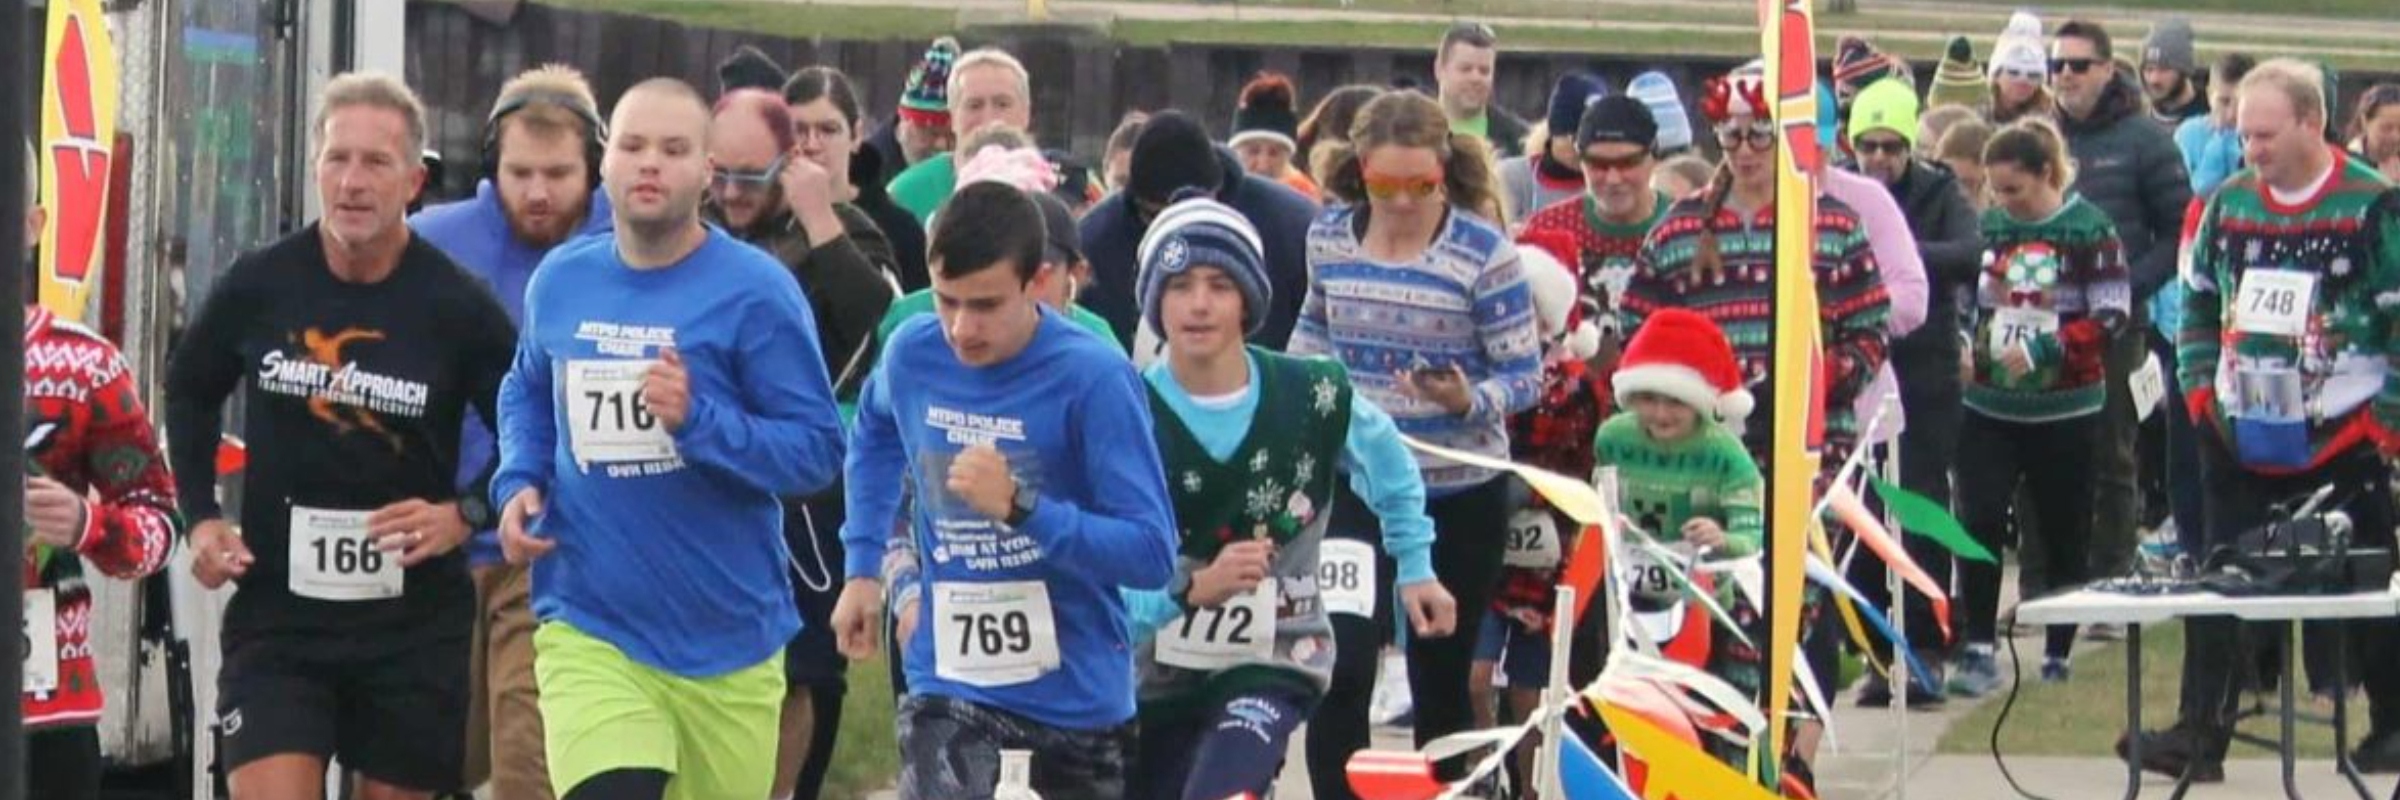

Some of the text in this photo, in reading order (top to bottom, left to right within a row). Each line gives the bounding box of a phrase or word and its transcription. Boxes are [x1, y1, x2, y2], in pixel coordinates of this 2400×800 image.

[2250, 287, 2296, 316] 748
[328, 360, 428, 407] APPROACH
[584, 390, 656, 431] 716
[966, 412, 1024, 436] POLICE
[311, 536, 384, 575] 166
[1320, 561, 1359, 591] 98
[951, 610, 1032, 656] 769
